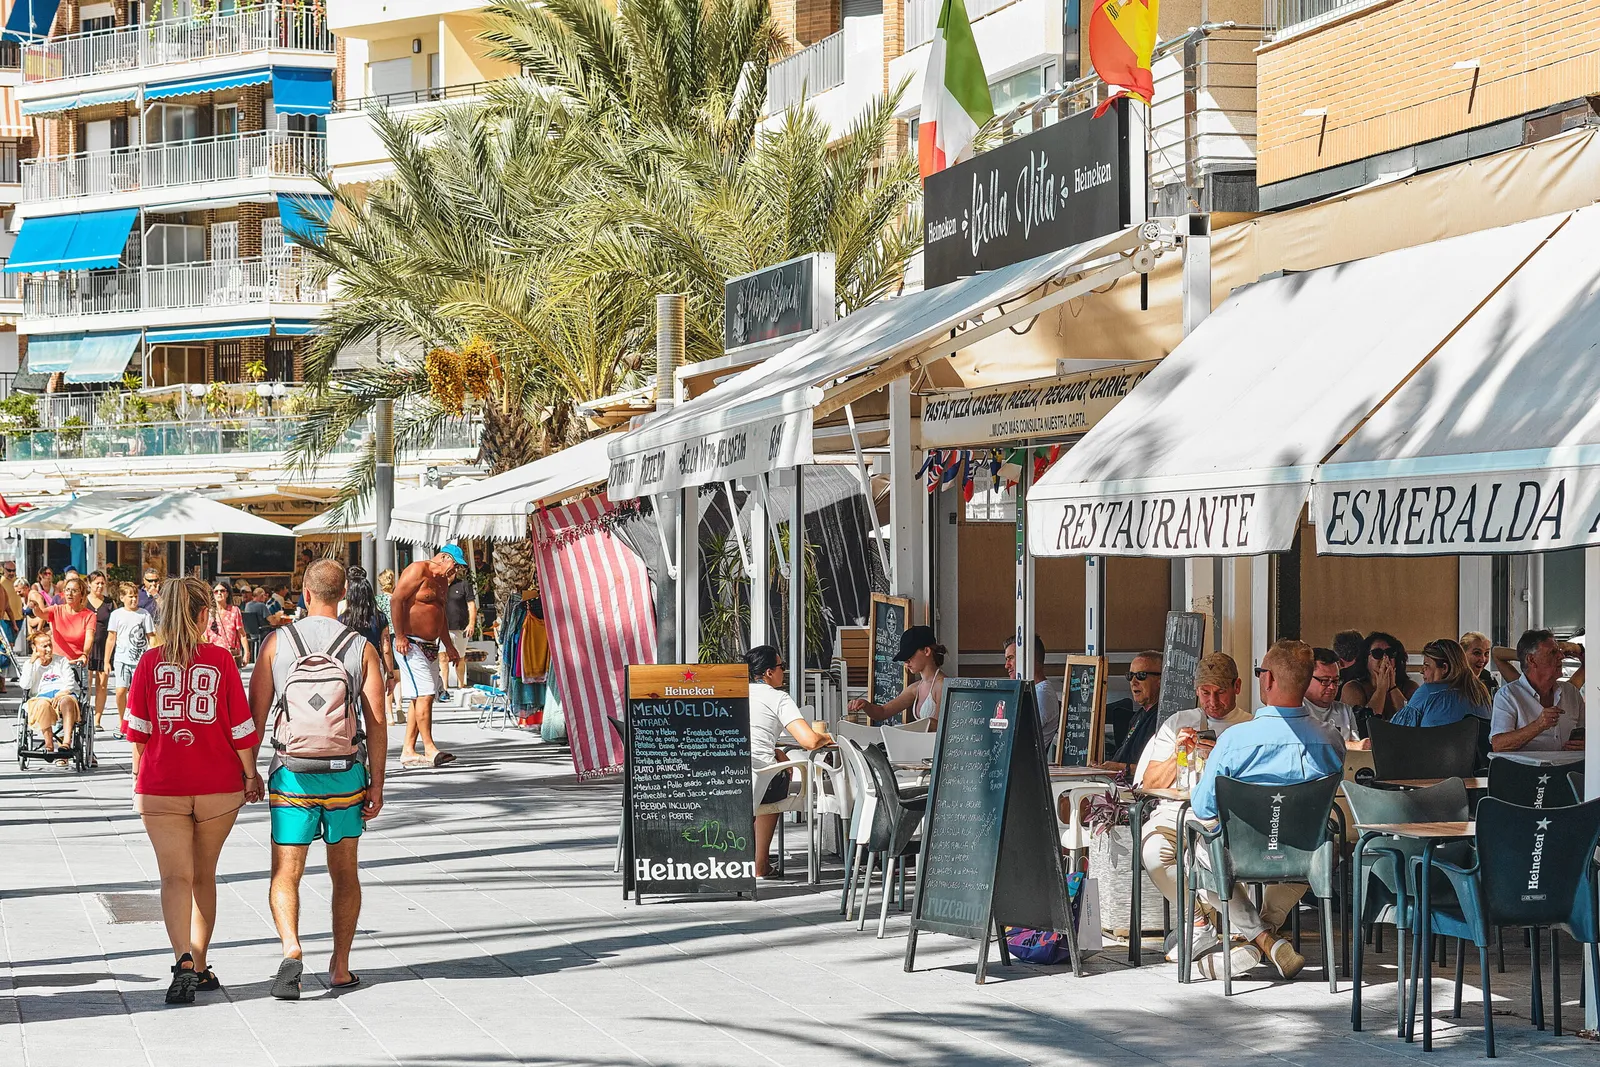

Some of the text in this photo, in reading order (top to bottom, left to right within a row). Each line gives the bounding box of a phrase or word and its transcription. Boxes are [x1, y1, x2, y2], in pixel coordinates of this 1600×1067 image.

[928, 150, 1112, 257] Heineken Bella Vita Heineken
[1089, 374, 1132, 399] CARNE,
[1056, 493, 1255, 550] RESTAURANTE
[1326, 478, 1566, 545] ESMERALDA
[154, 662, 221, 724] 28
[664, 686, 715, 696] Heineken
[674, 700, 700, 717] DEL
[667, 781, 683, 790] Pollo
[1534, 786, 1545, 809] eken
[640, 802, 667, 811] BEBIDA
[669, 802, 701, 811] INCLUIDA
[668, 812, 694, 820] POSTRE
[1268, 805, 1281, 850] Heineken
[635, 857, 757, 881] Heineken
[1528, 833, 1545, 890] Heineken
